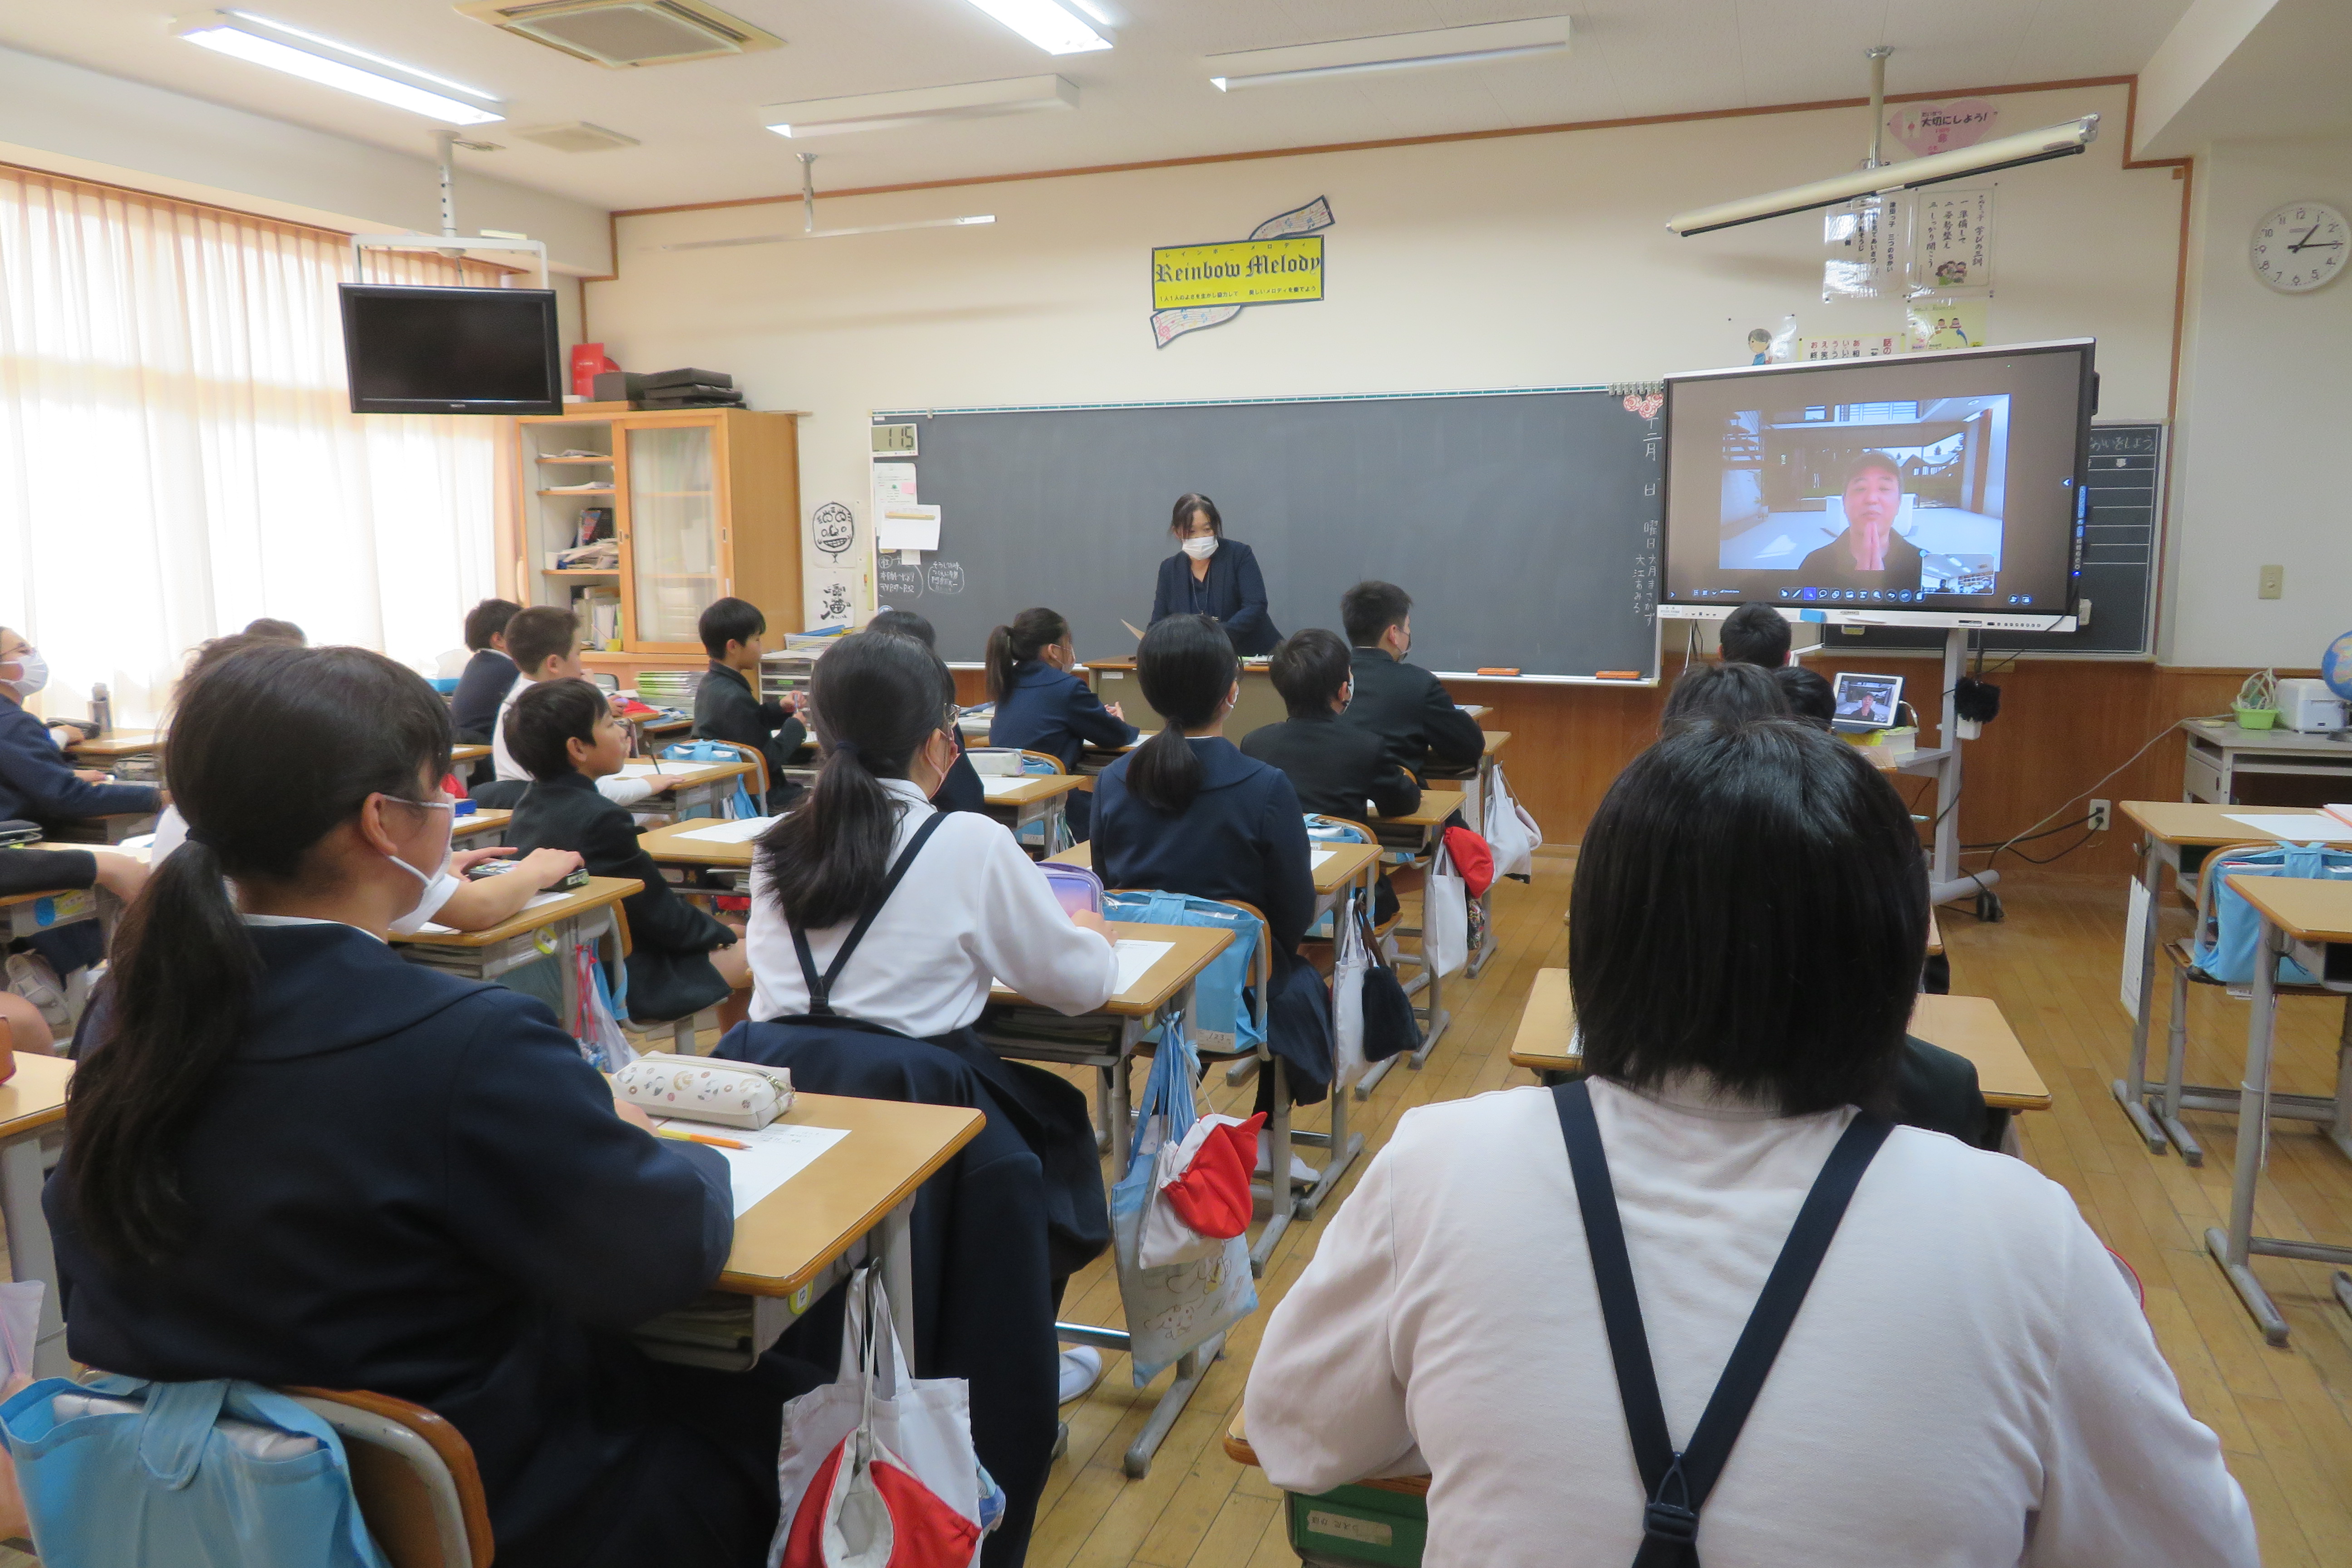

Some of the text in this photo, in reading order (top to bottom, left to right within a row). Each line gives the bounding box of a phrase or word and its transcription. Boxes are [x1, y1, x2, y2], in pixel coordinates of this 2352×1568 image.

[2296, 210, 2305, 220] 12
[2278, 216, 2287, 225] 11
[1957, 210, 1968, 244] 準備して
[2328, 223, 2336, 232] 2
[2263, 228, 2274, 238] 10
[2259, 245, 2267, 254] 9
[2262, 260, 2269, 270] 8
[2326, 257, 2335, 265] 4
[1156, 254, 1321, 283] Reinbow Melody
[2275, 271, 2283, 282] 7
[2311, 269, 2318, 279] 5
[2293, 275, 2300, 284] 6
[1643, 519, 1659, 549] 曜日
